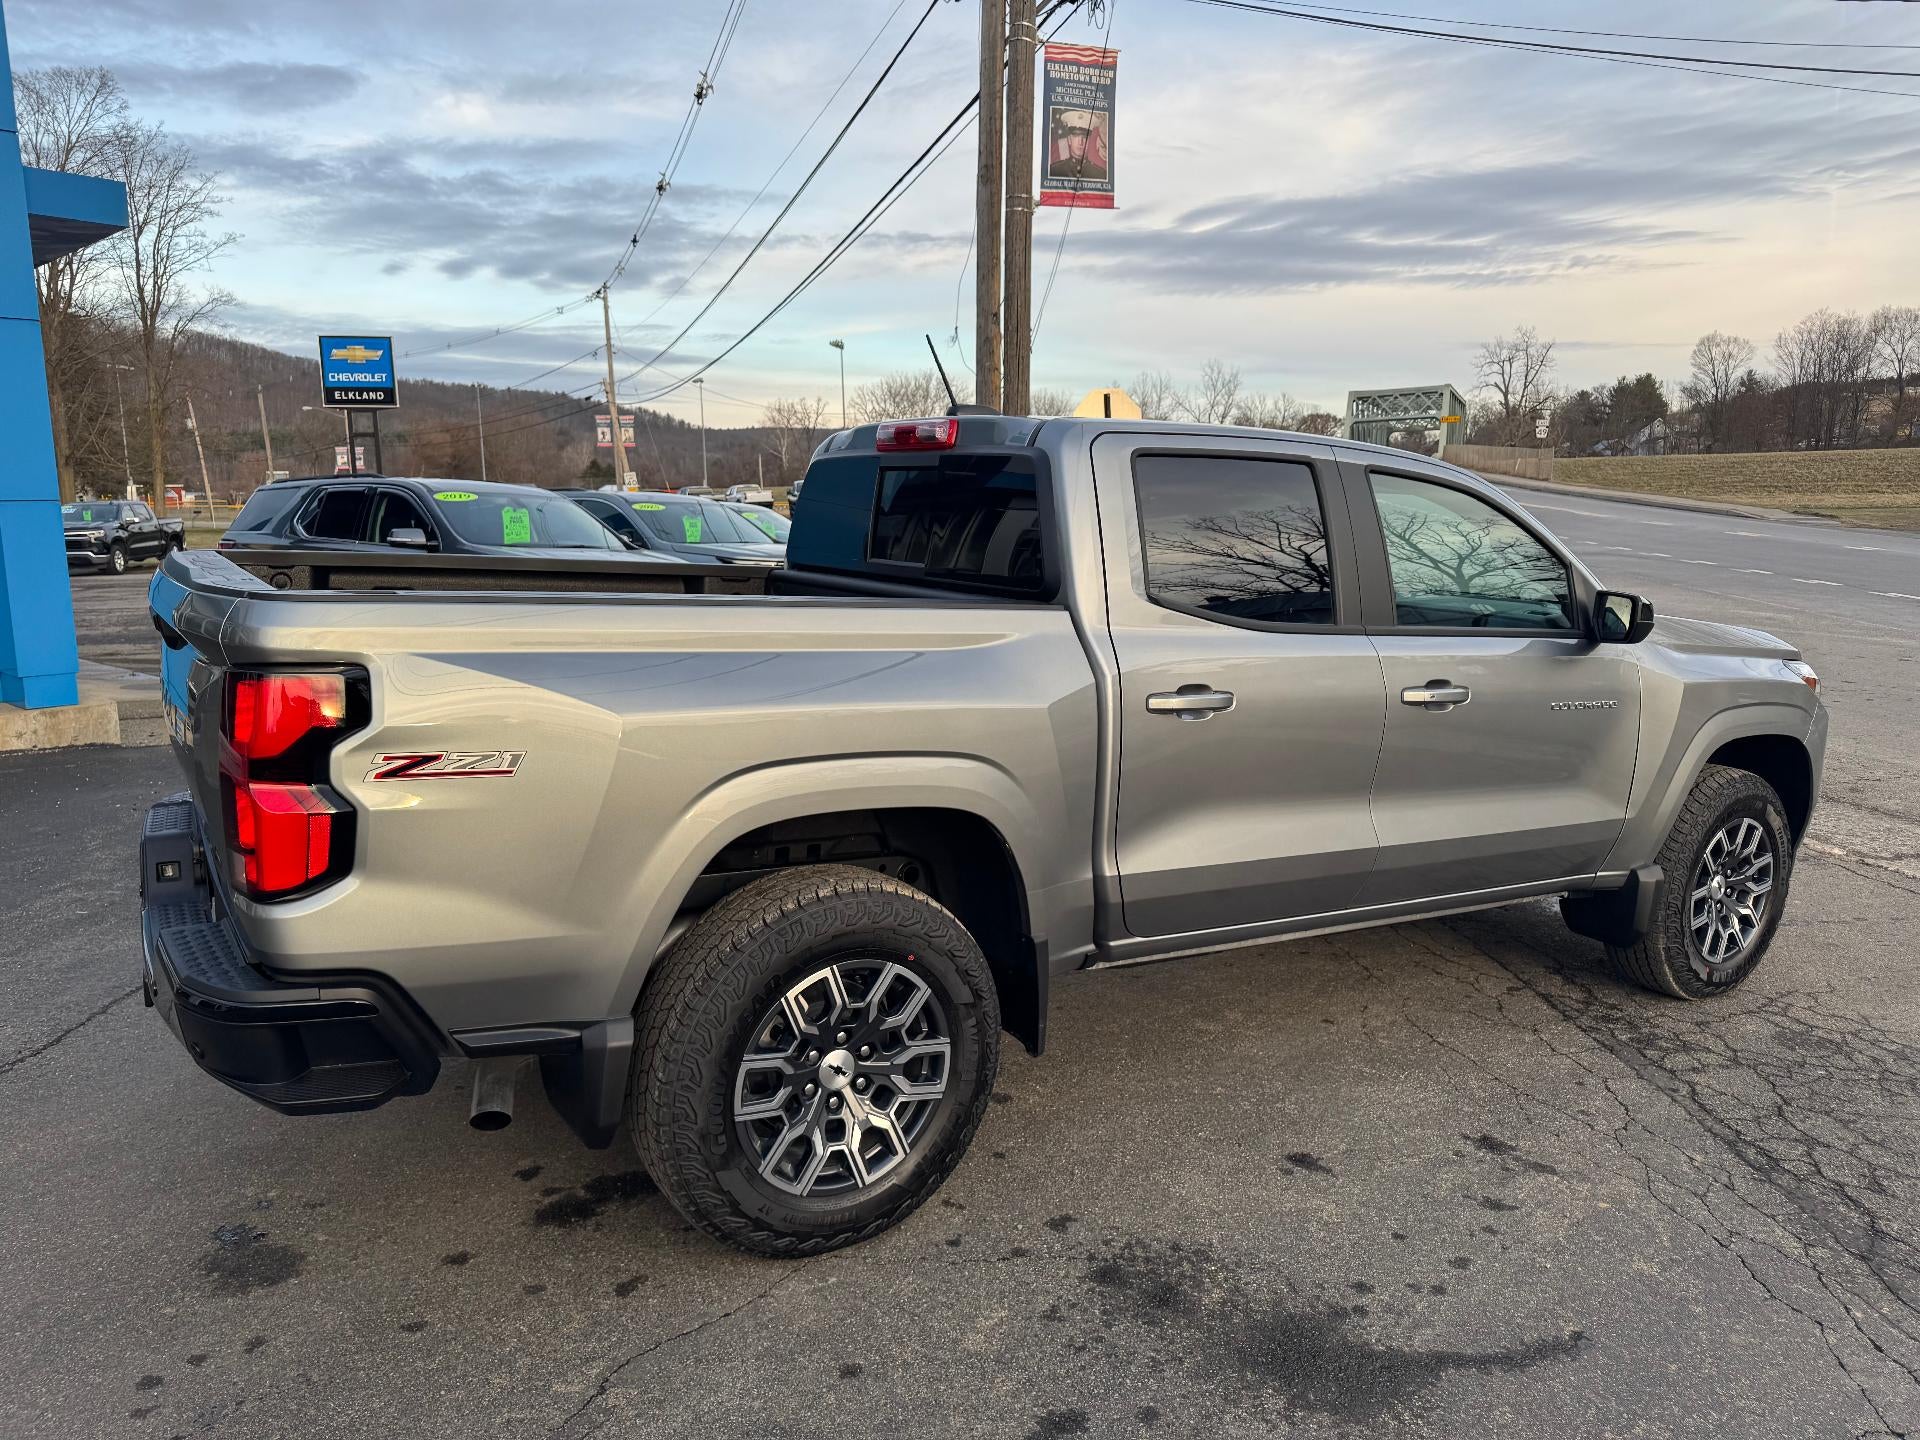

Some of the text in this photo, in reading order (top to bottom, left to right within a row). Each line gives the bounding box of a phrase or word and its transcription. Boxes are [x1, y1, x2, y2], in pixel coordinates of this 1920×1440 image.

[1047, 62, 1078, 73] ELKLAND
[1050, 70, 1090, 82] HOMETOWN
[1055, 86, 1084, 96] MICHAEL
[1064, 96, 1088, 106] MARINE
[328, 372, 388, 382] CHEVROLET
[334, 390, 385, 400] ELKLAND
[1550, 700, 1619, 711] COLORADO
[363, 750, 527, 783] Z71
